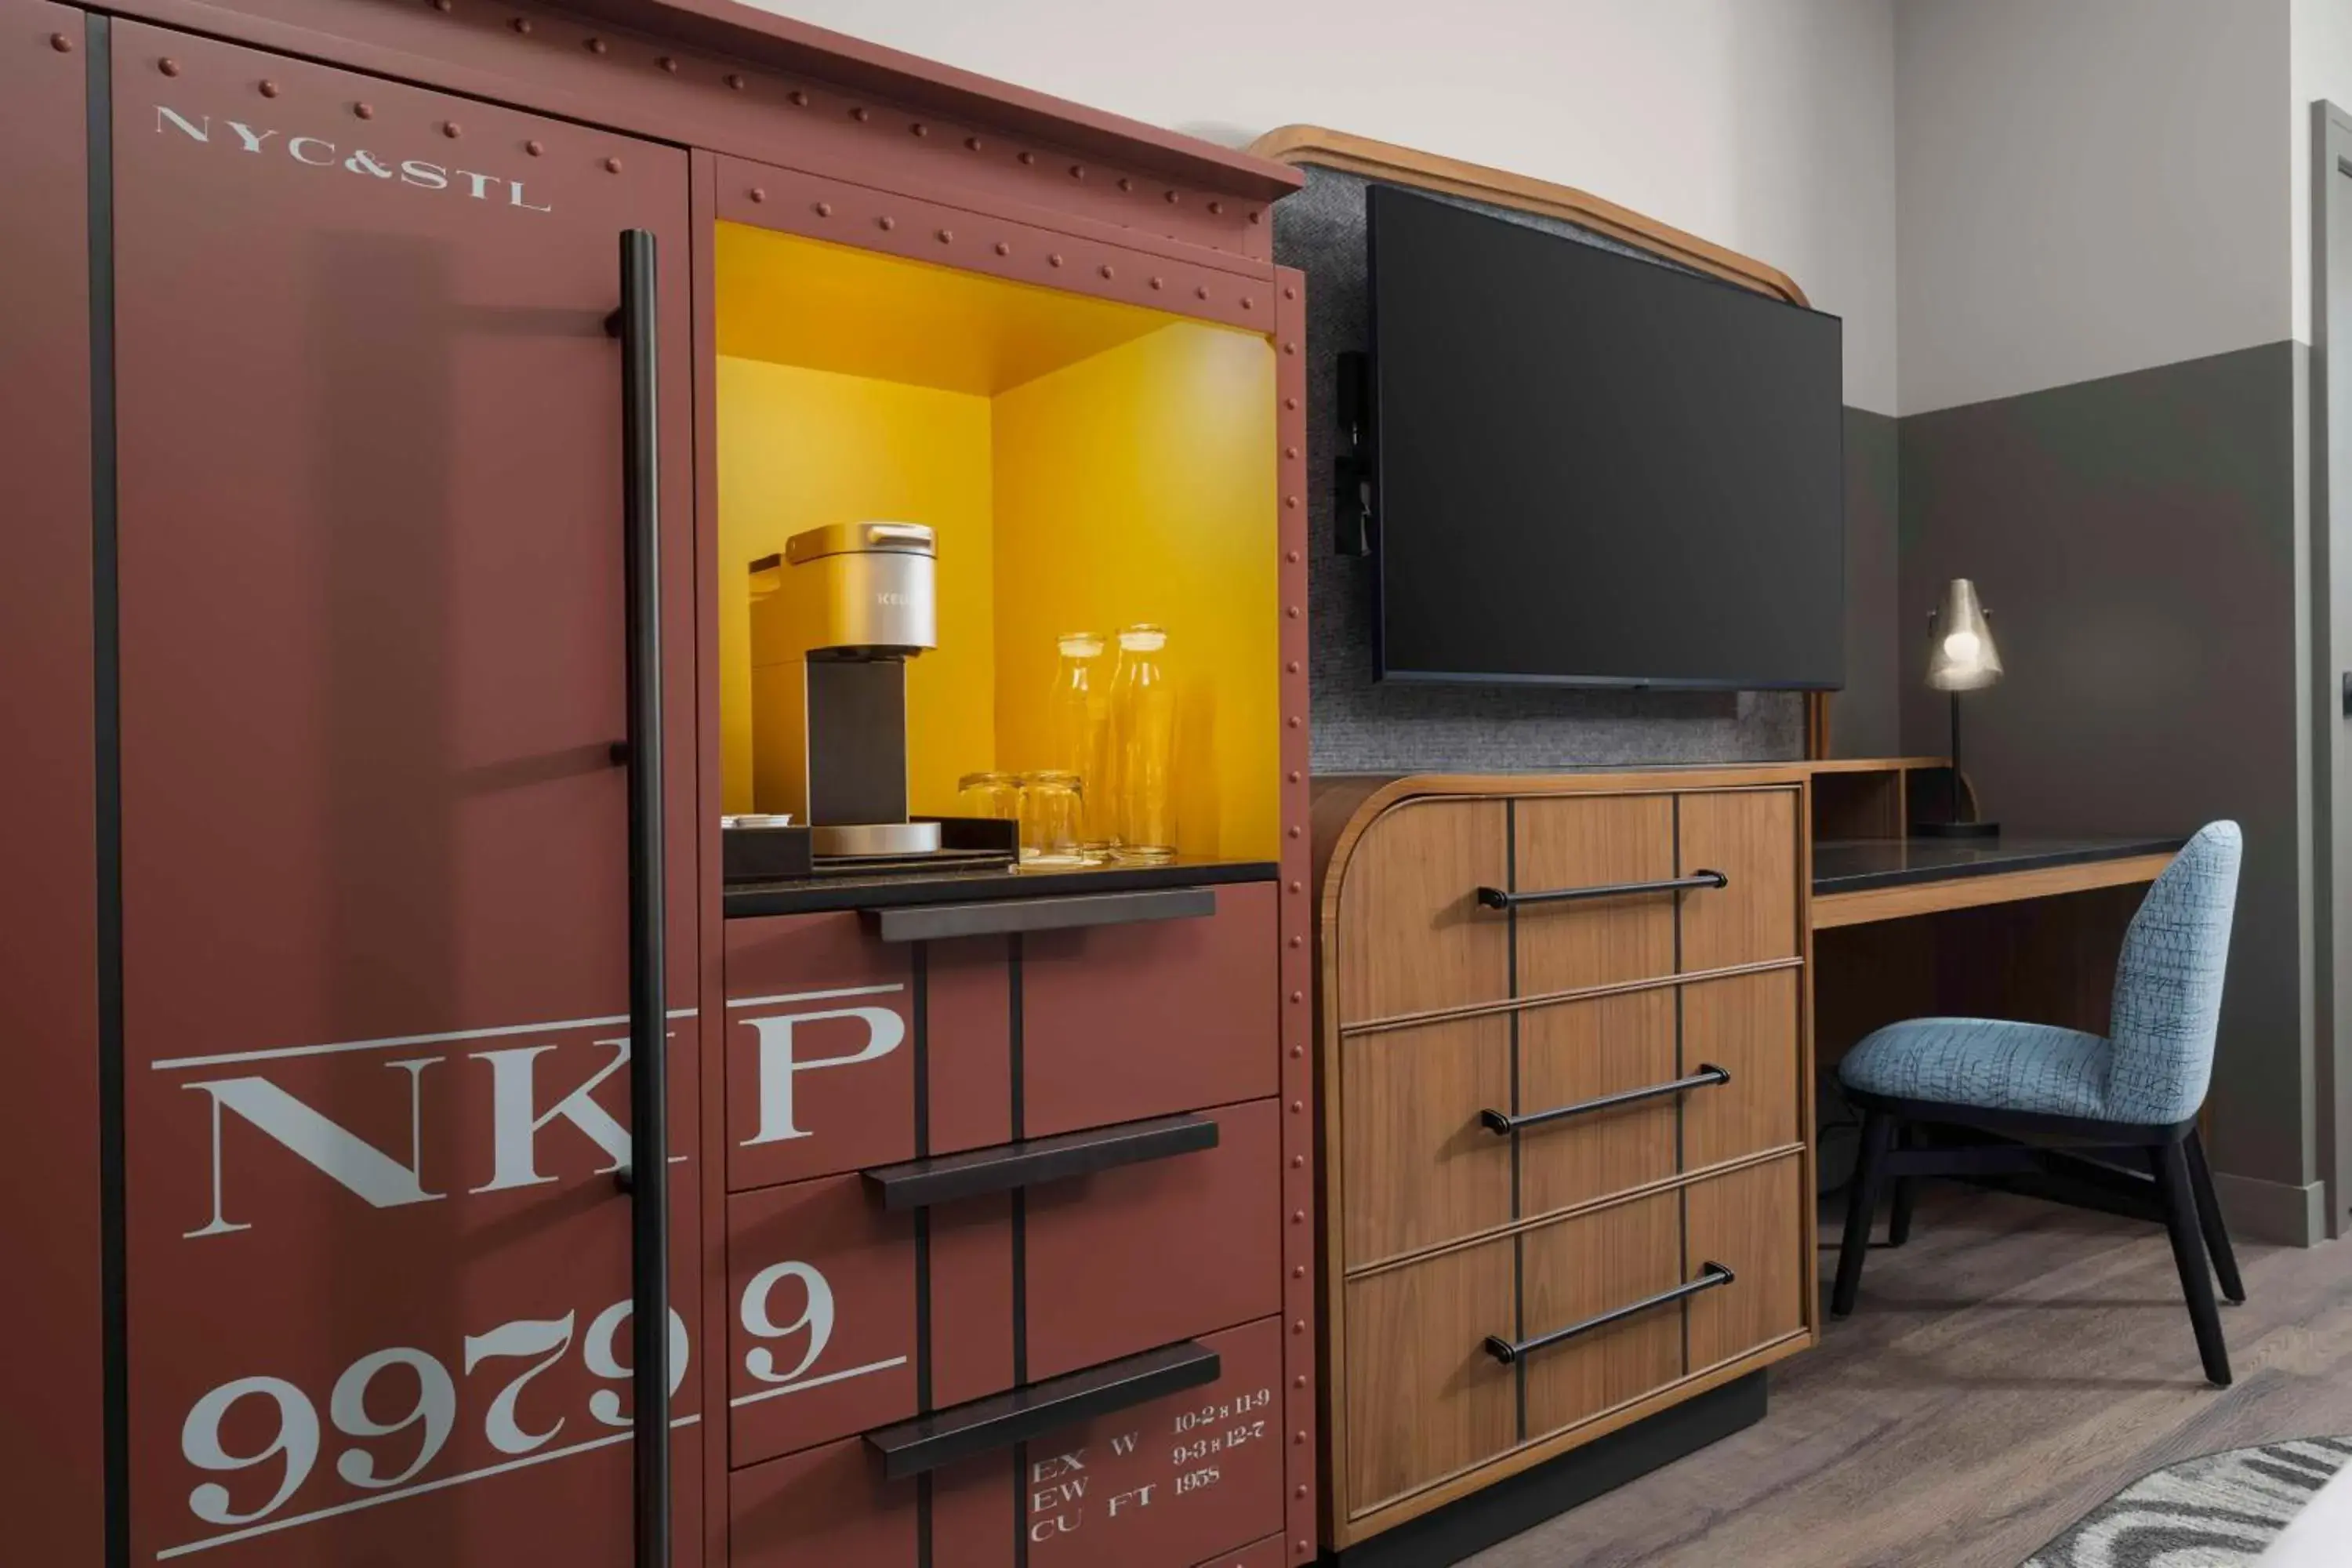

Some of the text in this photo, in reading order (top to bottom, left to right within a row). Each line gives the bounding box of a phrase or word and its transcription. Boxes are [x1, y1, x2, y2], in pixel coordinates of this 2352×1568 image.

[154, 104, 552, 212] NYC&STL
[1032, 1476, 1089, 1513] EW
[1173, 1439, 1207, 1465] 9-3
[1033, 1450, 1085, 1483] EX
[1111, 1432, 1138, 1456] W
[1176, 1406, 1214, 1434] 10-2
[1031, 1508, 1083, 1542] CU
[1106, 1483, 1157, 1517] FT
